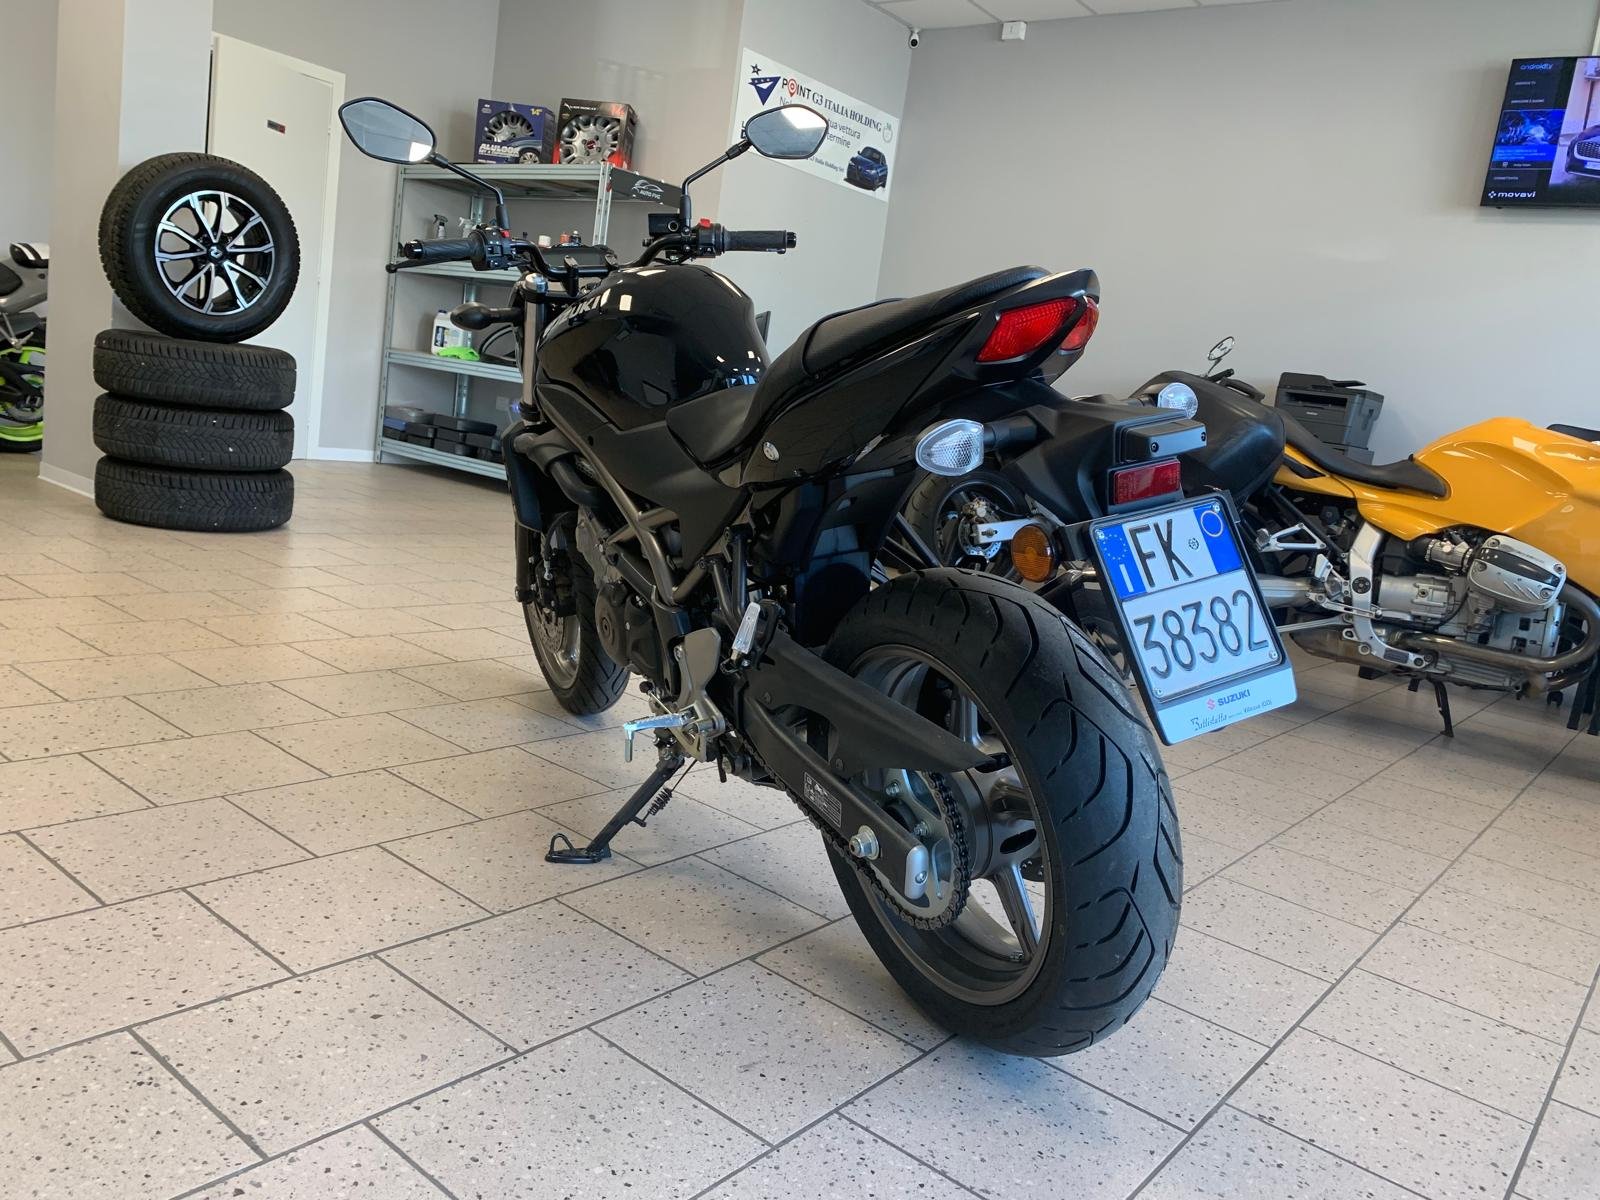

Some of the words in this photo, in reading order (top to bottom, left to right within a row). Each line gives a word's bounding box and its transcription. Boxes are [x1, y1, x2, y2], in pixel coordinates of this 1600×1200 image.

[781, 78, 811, 99] POINT
[812, 92, 823, 105] G3
[824, 99, 849, 118] ITALIA
[850, 110, 882, 132] HOLDING
[838, 123, 861, 139] vettura
[1497, 190, 1536, 199] movavi
[1128, 518, 1194, 588] FK
[1133, 589, 1269, 679] 38382
[1217, 688, 1252, 707] SUZUKI
